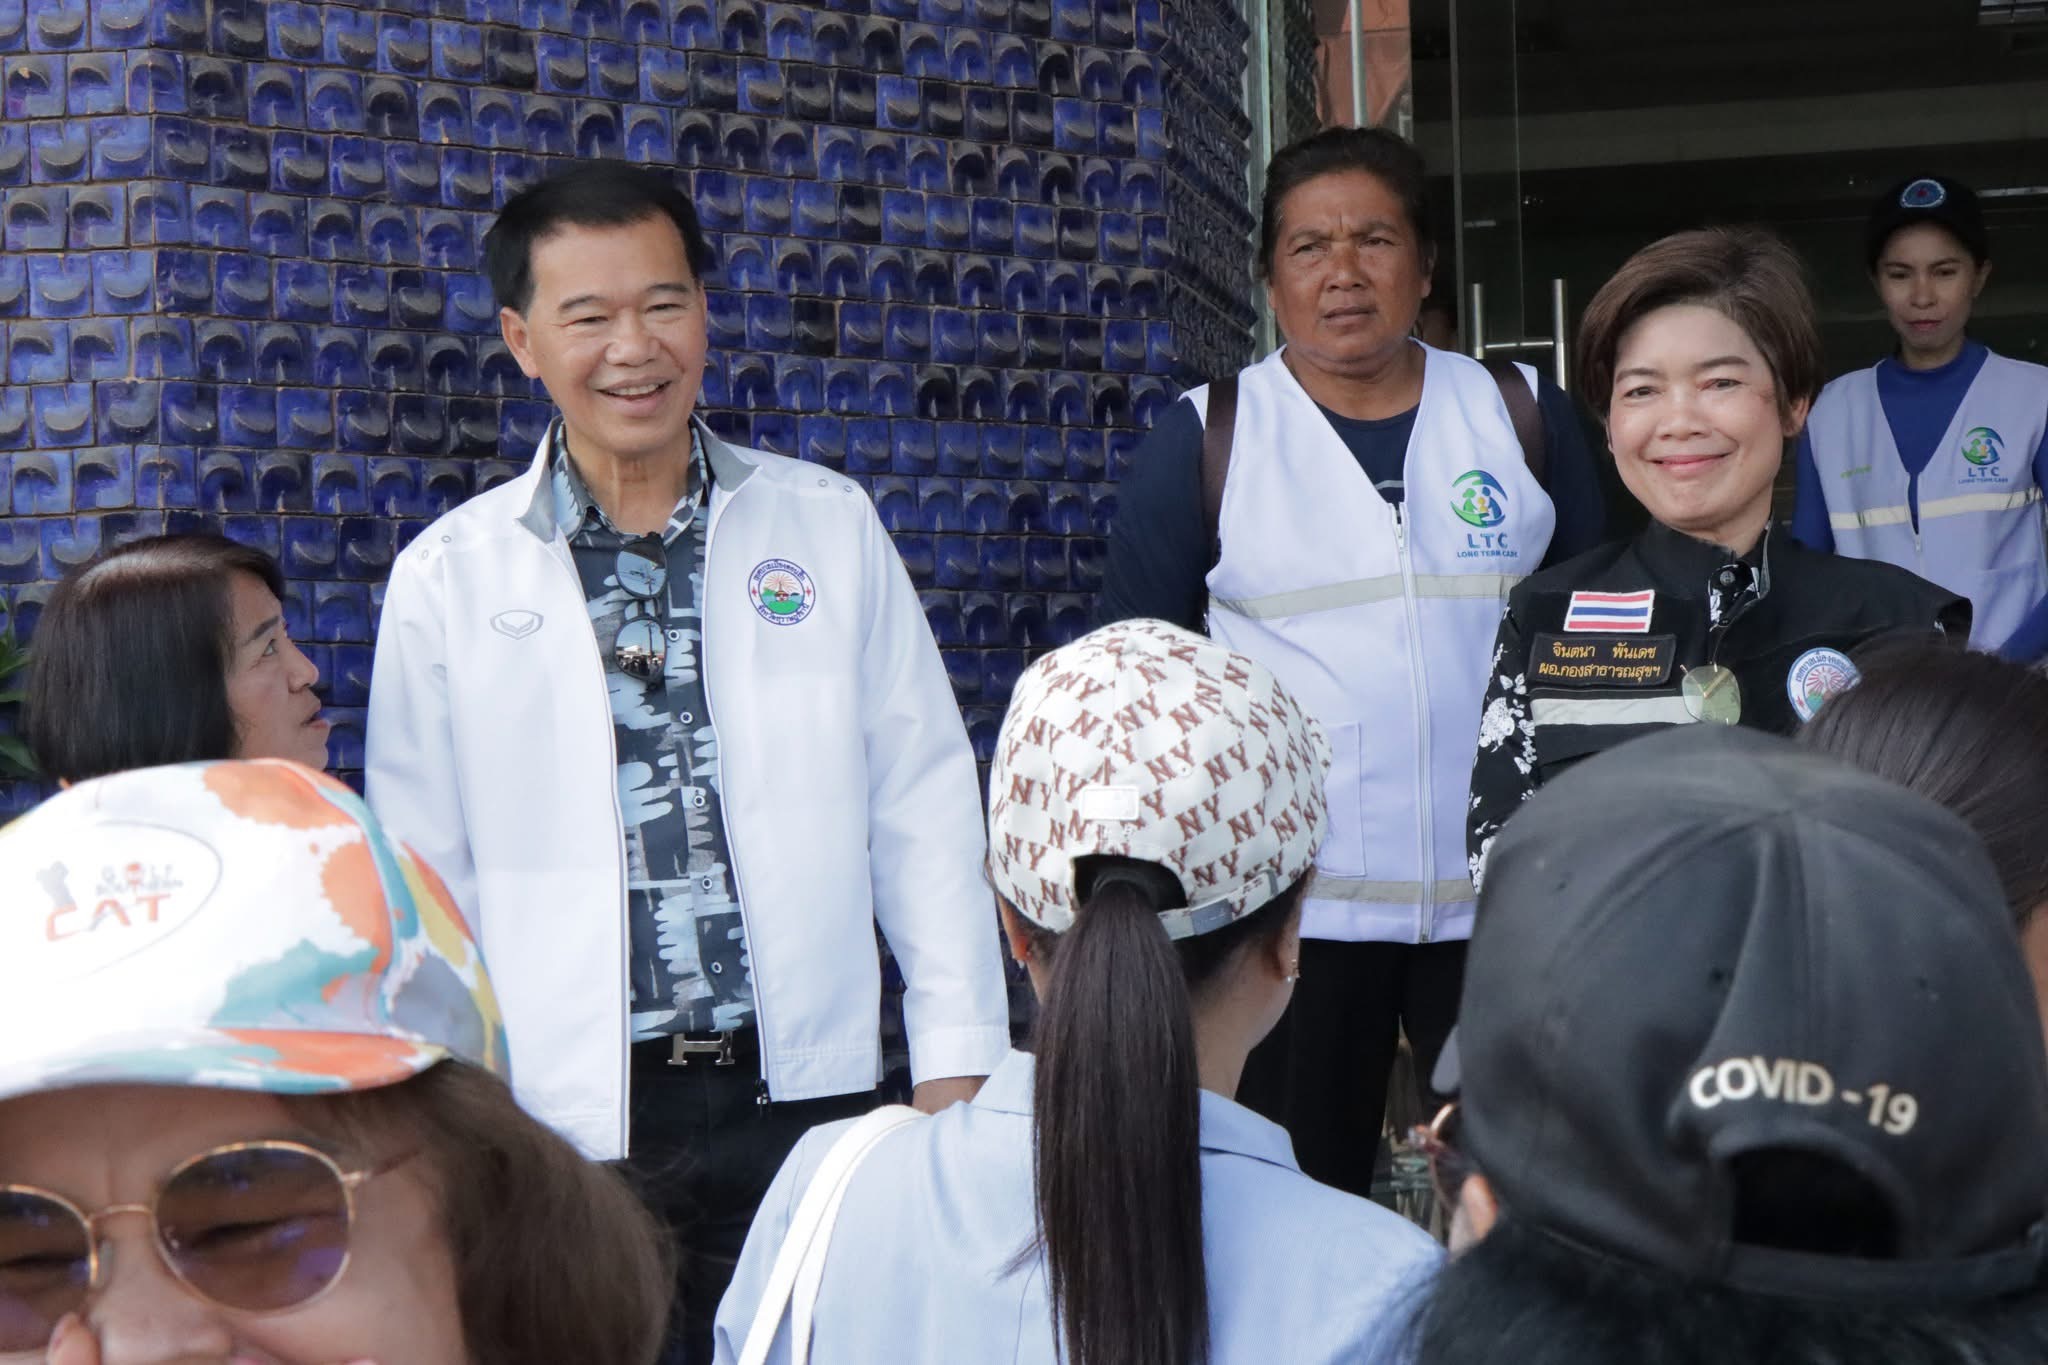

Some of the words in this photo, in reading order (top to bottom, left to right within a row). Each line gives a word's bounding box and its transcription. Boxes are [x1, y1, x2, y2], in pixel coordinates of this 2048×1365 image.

[1967, 466, 1999, 477] LTC
[1467, 532, 1508, 549] LTC
[1552, 641, 1596, 659] จินตนา
[1023, 716, 1065, 752] NY
[1144, 738, 1196, 785] NY
[1203, 740, 1250, 789] NY
[1009, 773, 1051, 811] NY
[1174, 793, 1221, 842] NY
[1005, 832, 1048, 870] NY
[1192, 848, 1239, 888] NY
